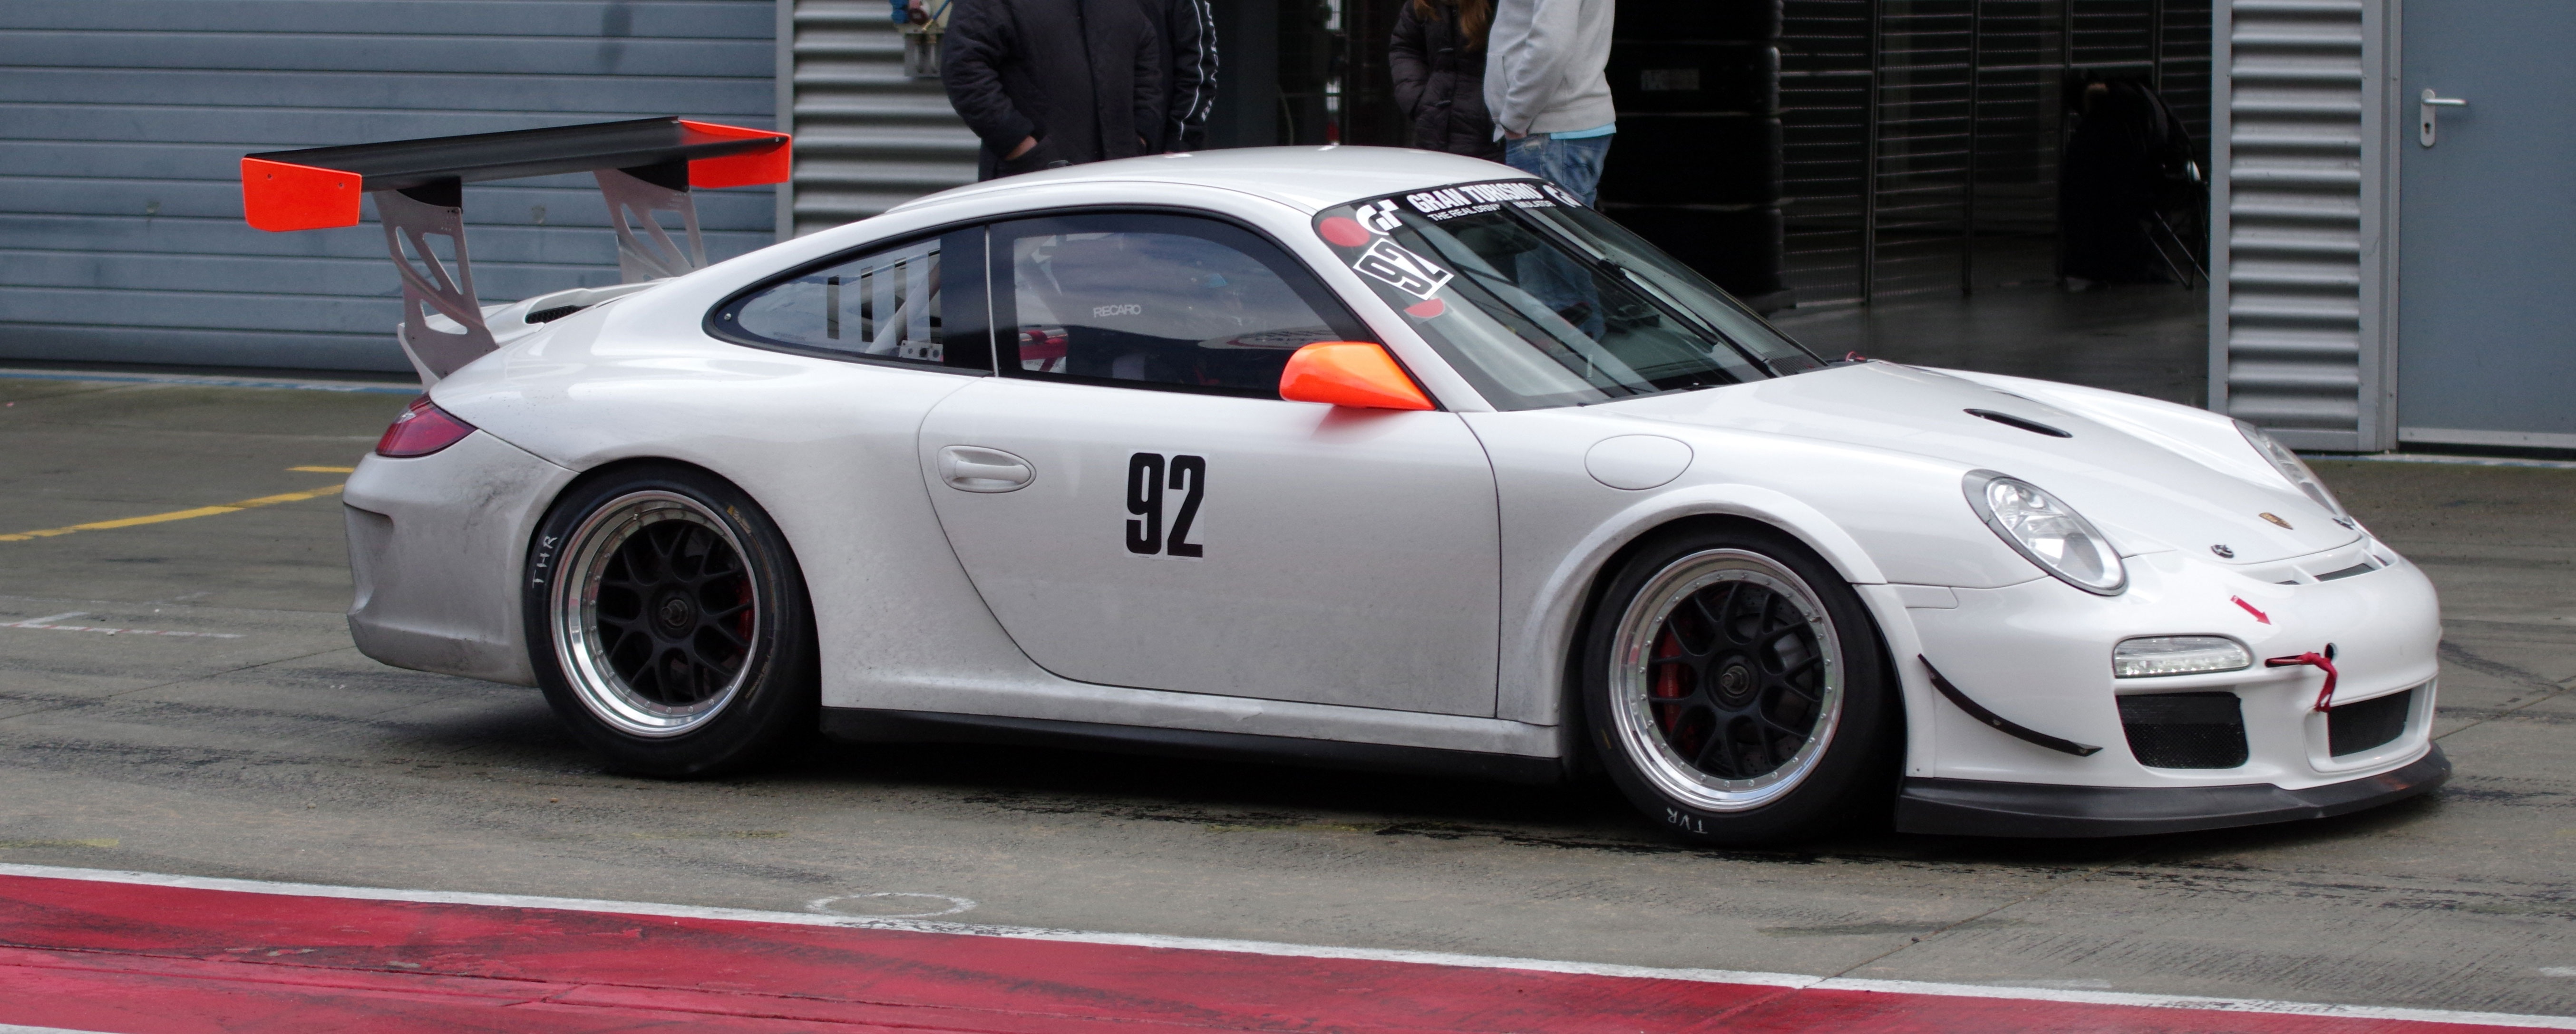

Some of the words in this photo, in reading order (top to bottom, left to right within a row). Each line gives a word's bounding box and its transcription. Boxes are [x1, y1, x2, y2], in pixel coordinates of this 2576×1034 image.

[1406, 188, 1472, 213] GRAN
[1458, 183, 1544, 203] TURISMO
[1427, 212, 1453, 221] THE
[1448, 207, 1478, 217] REAL
[1472, 203, 1500, 213] DRIVI
[1512, 200, 1556, 208] IMULATOR
[1359, 241, 1448, 295] 92
[1093, 304, 1141, 318] RECARO
[1126, 452, 1206, 558] 92
[532, 535, 558, 589] THR
[1666, 807, 1708, 834] TVR
